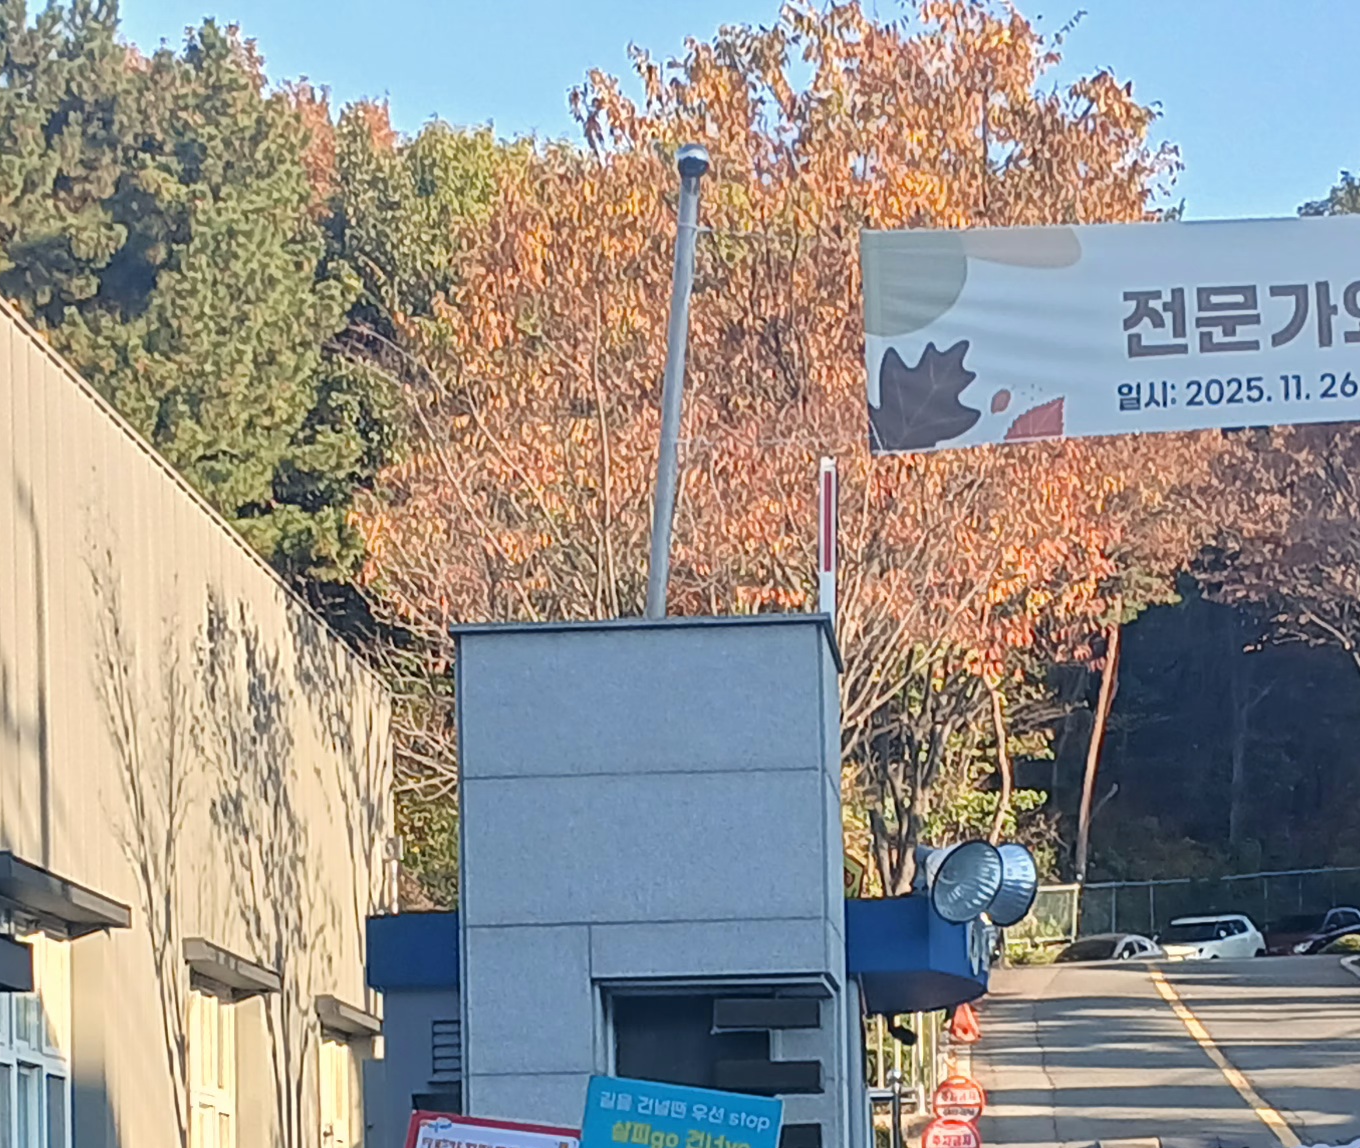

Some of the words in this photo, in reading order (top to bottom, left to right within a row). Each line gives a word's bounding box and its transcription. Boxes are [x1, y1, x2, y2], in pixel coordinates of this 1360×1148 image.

[1117, 380, 1178, 411] 일시:
[691, 1103, 725, 1124] 우선
[728, 1110, 771, 1134] stop
